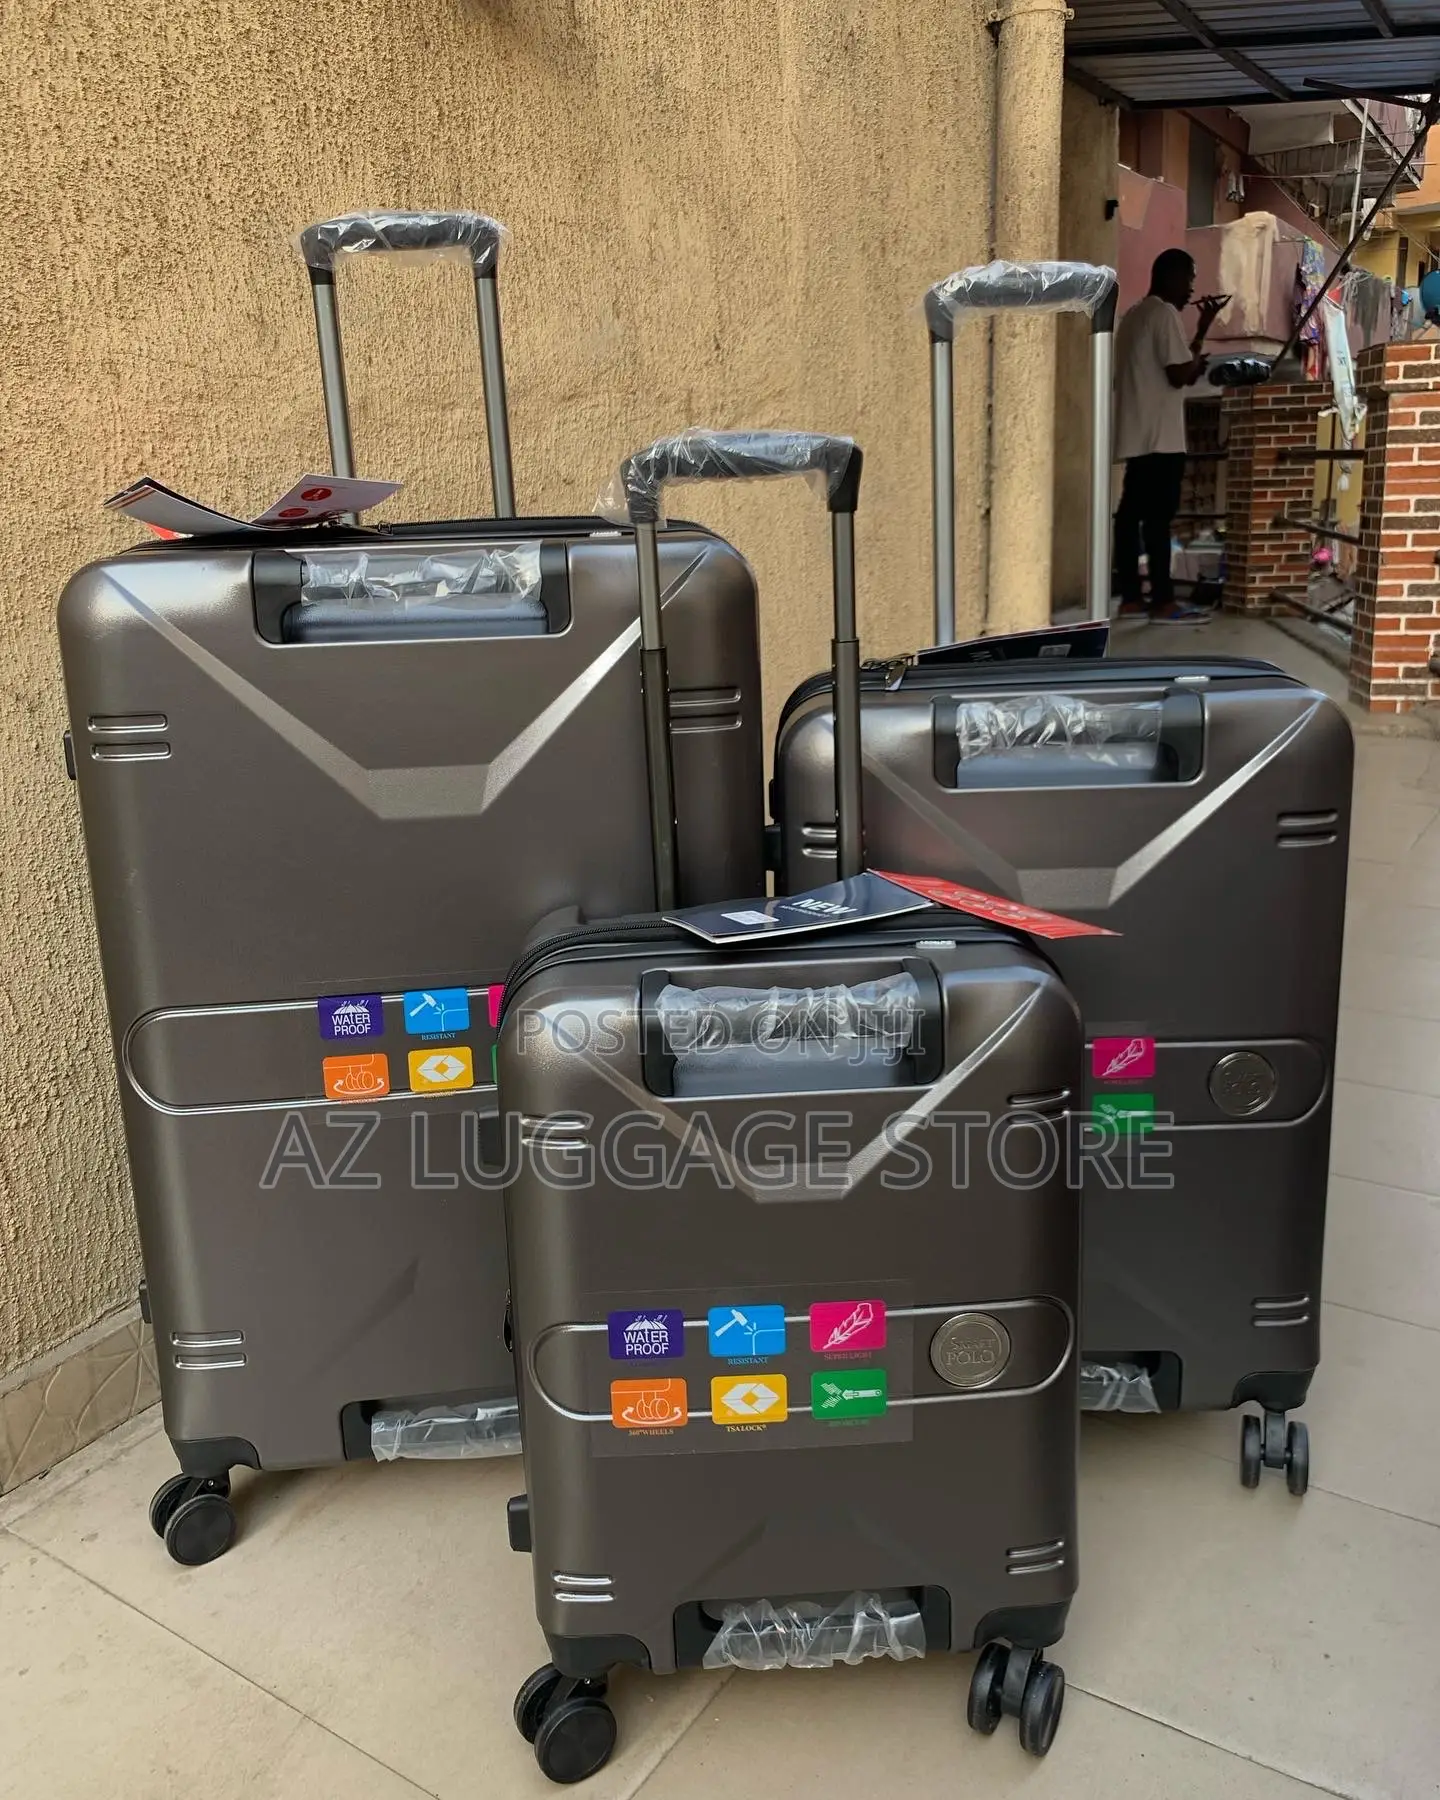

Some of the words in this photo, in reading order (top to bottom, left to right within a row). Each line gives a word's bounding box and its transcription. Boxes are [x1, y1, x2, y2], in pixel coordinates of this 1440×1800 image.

[791, 898, 858, 914] NEW
[334, 1023, 371, 1035] PROOF
[421, 1032, 456, 1041] RESISTANT
[625, 1343, 669, 1356] PROOF
[727, 1356, 769, 1365] RESISTANT
[946, 1349, 996, 1366] POLO
